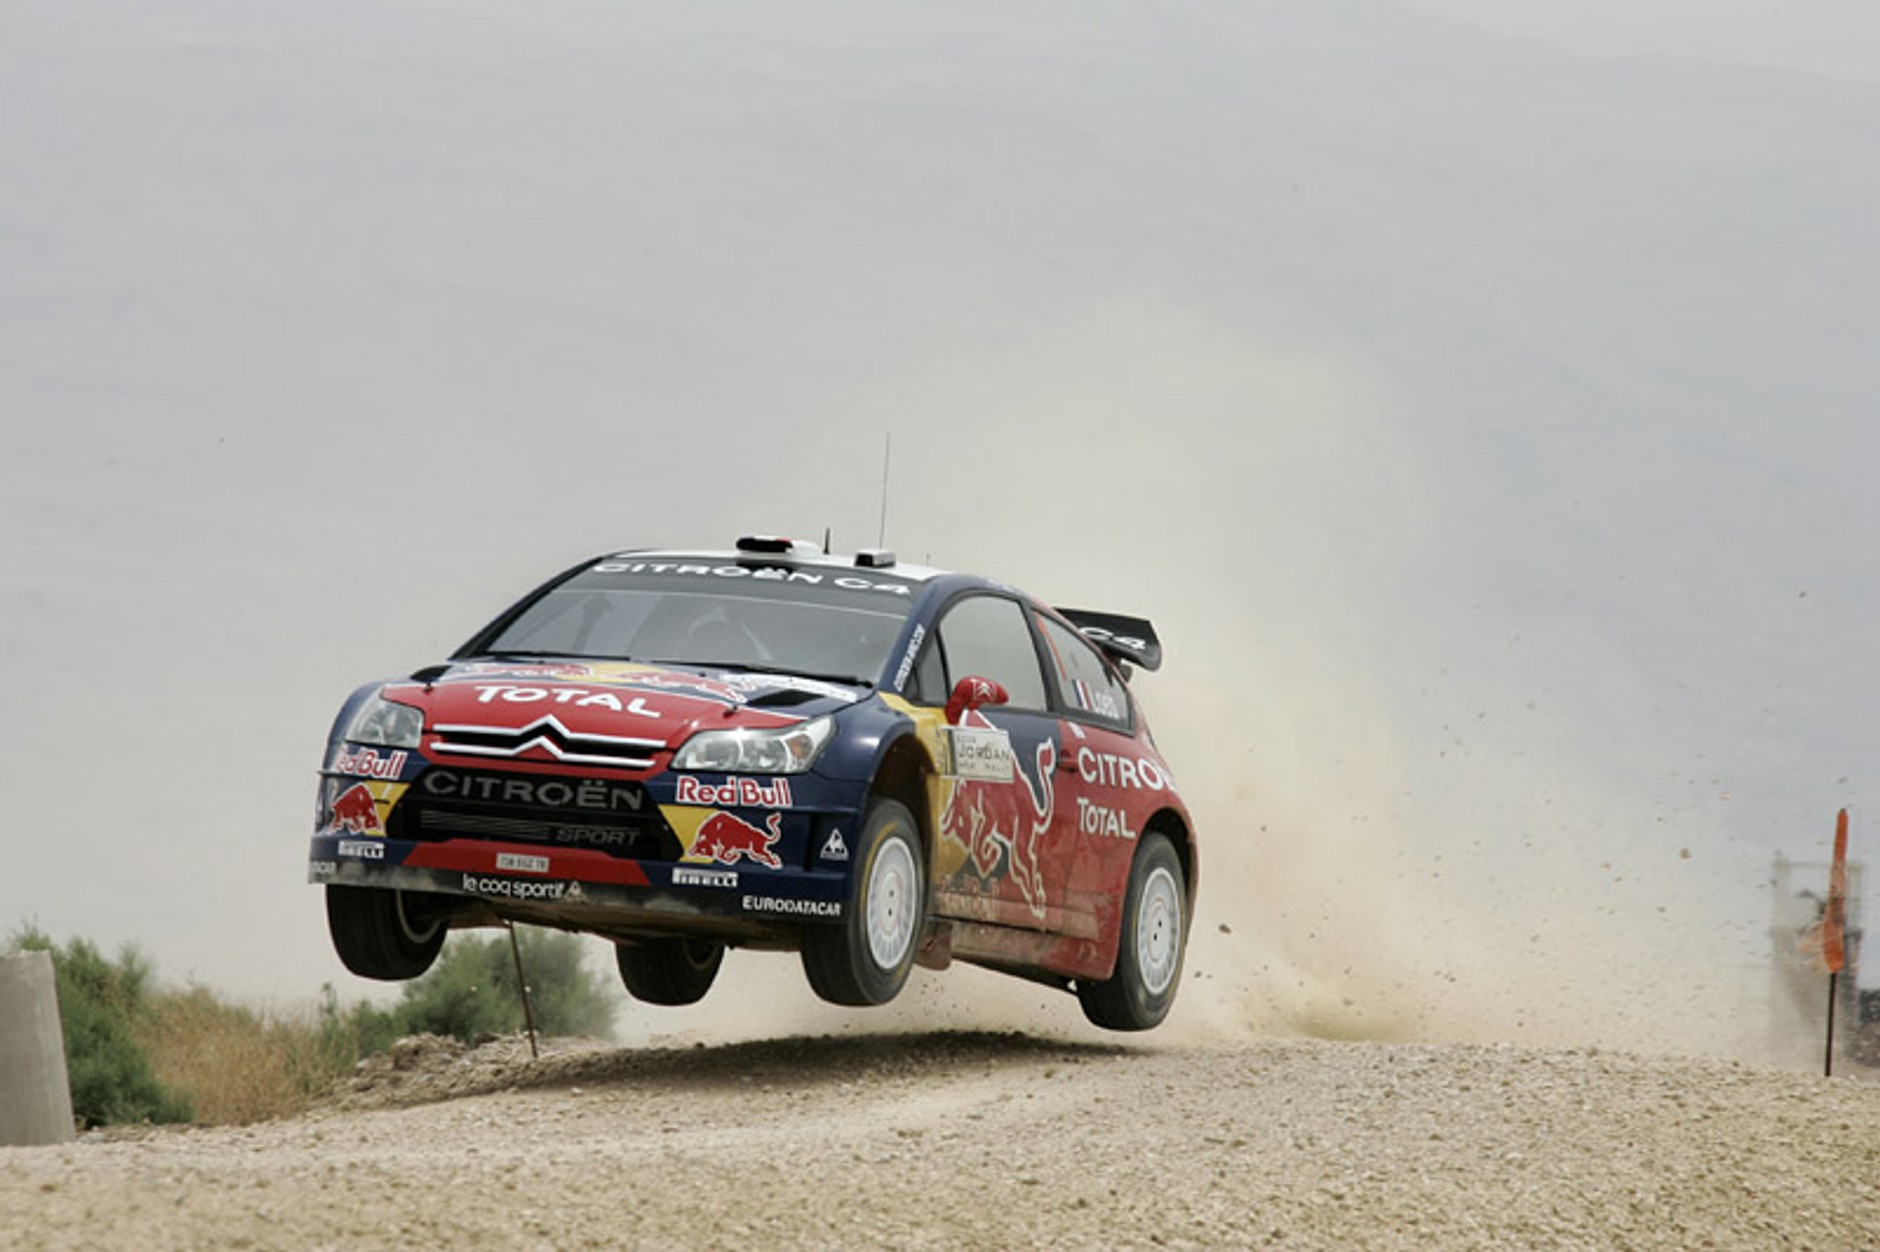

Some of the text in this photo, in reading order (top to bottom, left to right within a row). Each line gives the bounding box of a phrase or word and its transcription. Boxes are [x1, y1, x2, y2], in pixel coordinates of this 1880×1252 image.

[591, 562, 911, 596] CITROËN C4
[475, 685, 661, 718] TOTAL
[1078, 746, 1178, 791] CITRO
[424, 769, 644, 811] CITROËN
[676, 775, 793, 807] Red Bull
[1077, 797, 1136, 839] TOTAL
[555, 827, 641, 846] SPORT
[478, 880, 511, 896] coq
[512, 881, 565, 899] sportif
[672, 867, 739, 888] PIRELLI
[742, 895, 842, 917] EURODATACAR
